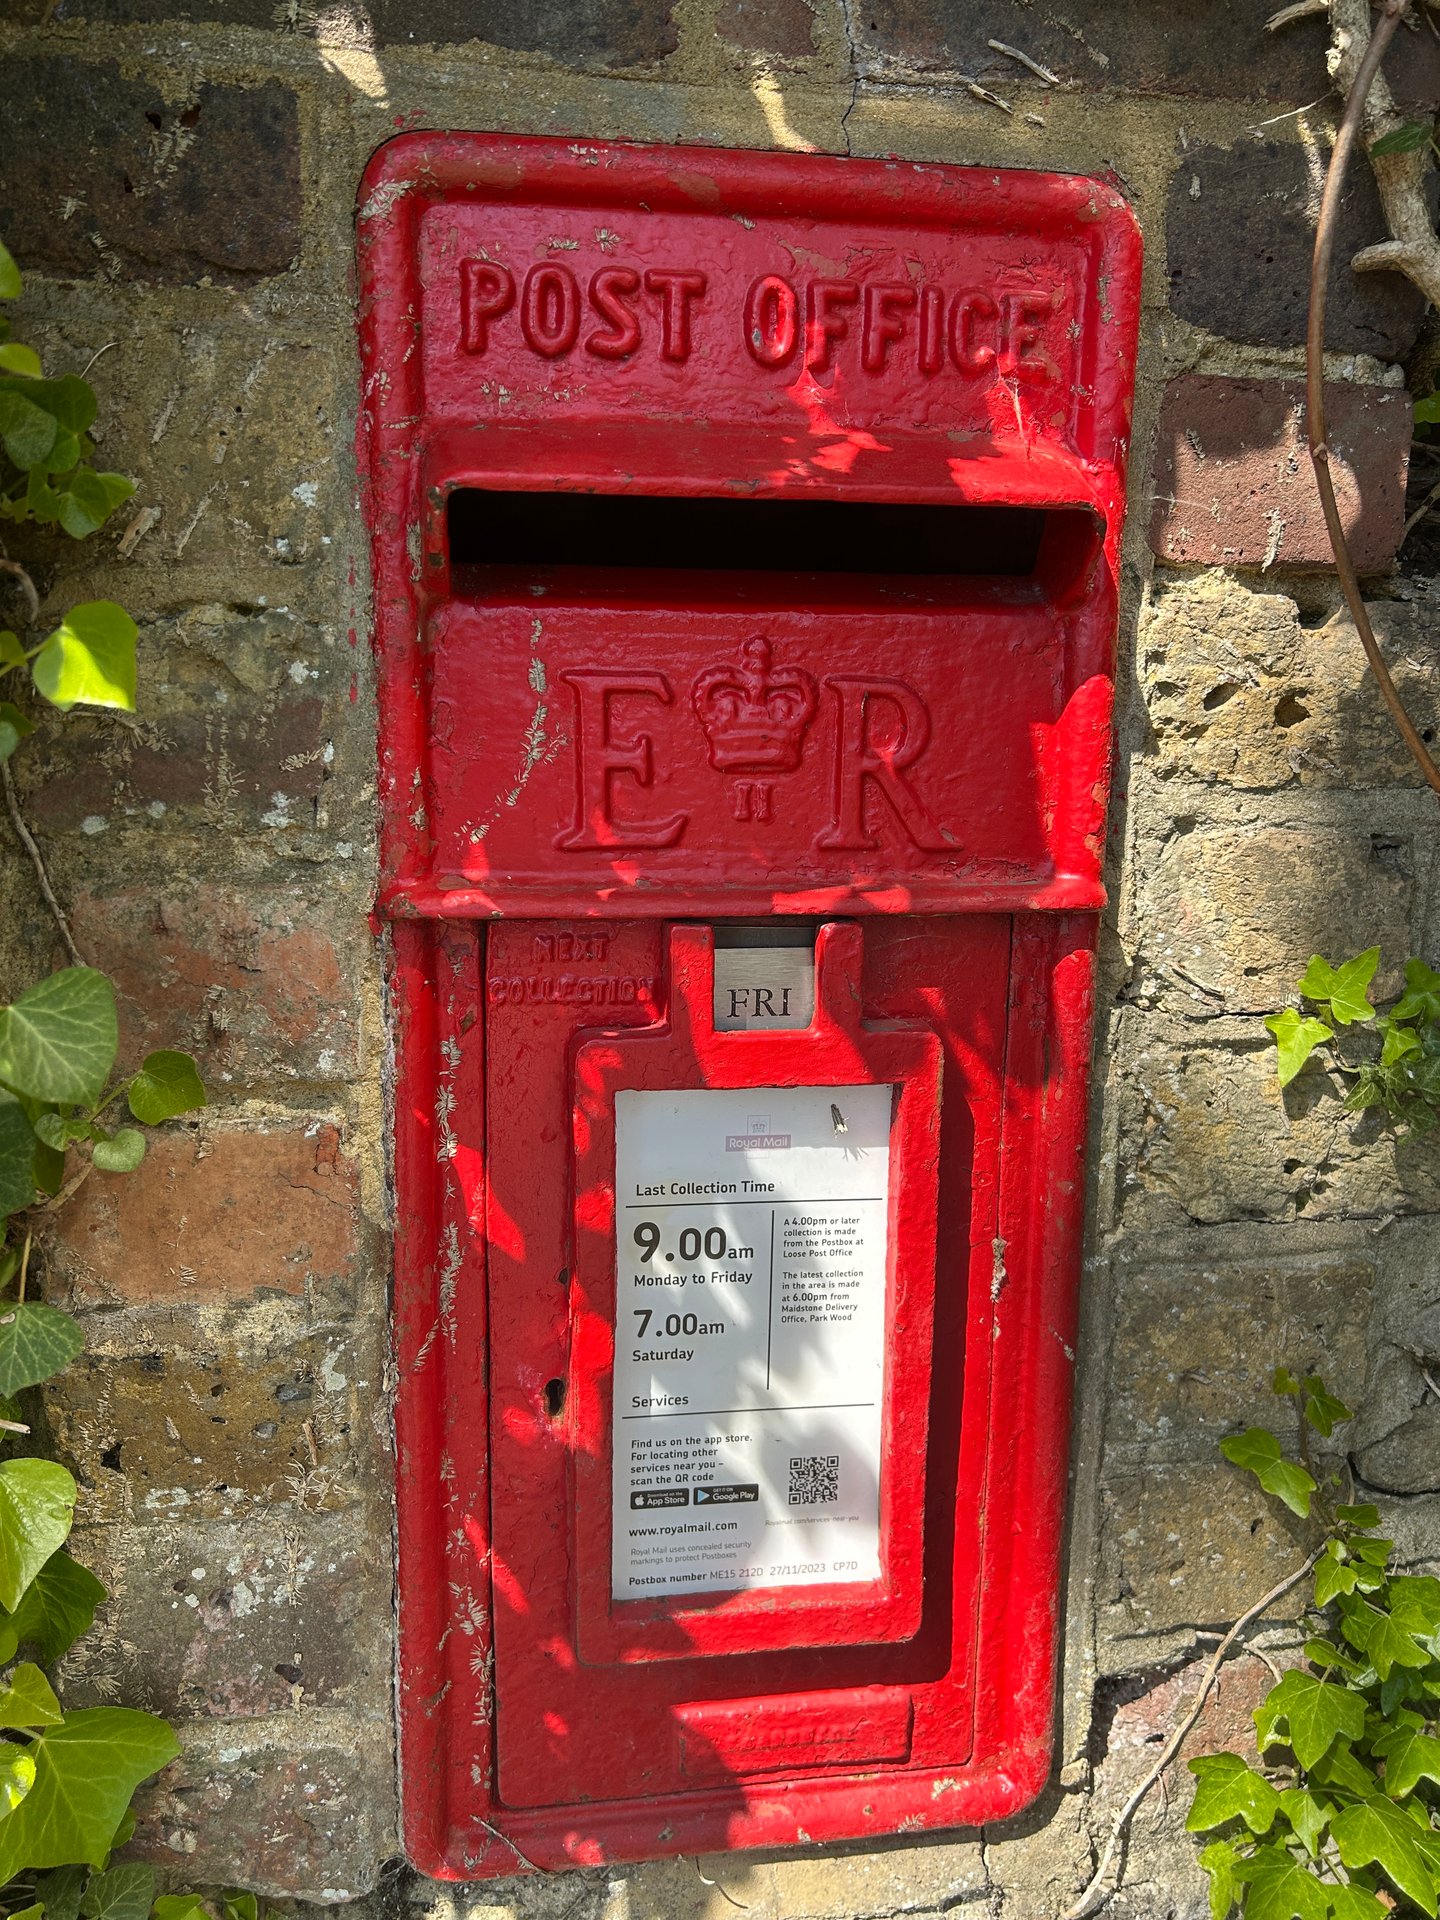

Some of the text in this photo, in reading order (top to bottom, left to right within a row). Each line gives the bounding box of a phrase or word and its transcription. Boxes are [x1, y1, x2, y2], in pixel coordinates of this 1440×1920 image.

[459, 259, 1055, 378] POST OFFICE
[551, 667, 963, 851] E R
[531, 931, 610, 962] NEXT
[489, 973, 654, 1005] COLLECTION
[727, 988, 792, 1018] FRI
[729, 1136, 788, 1150] Royal Mail
[636, 1180, 775, 1196] Last Collection Time
[784, 1218, 790, 1226] A
[792, 1216, 827, 1227] 4.00pm
[841, 1217, 860, 1225] later
[784, 1227, 856, 1237] collection is made
[633, 1221, 754, 1264] 9.00am
[784, 1239, 803, 1248] from
[806, 1239, 819, 1247] the
[821, 1238, 853, 1246] Postbox
[783, 1248, 853, 1258] Loose Post Office
[634, 1271, 753, 1288] Monday to Friday
[782, 1269, 864, 1279] The latest collection
[782, 1282, 789, 1290] in
[792, 1281, 806, 1289] the
[829, 1280, 835, 1288] is
[838, 1280, 860, 1288] made
[781, 1292, 849, 1303] at 6.00pm from
[781, 1302, 858, 1313] Maidstone Delivery
[633, 1309, 725, 1338] 7.00am
[809, 1314, 828, 1322] Park
[829, 1313, 852, 1321] Wood
[632, 1348, 694, 1362] Saturday
[632, 1394, 689, 1408] Services
[631, 1435, 753, 1449] Find us on the app store.
[631, 1447, 718, 1461] For locating other
[630, 1463, 670, 1474] services
[673, 1462, 696, 1471] near
[698, 1461, 716, 1471] you
[630, 1472, 714, 1486] scan the QR code
[647, 1496, 685, 1506] App Store
[712, 1491, 755, 1502] Google Play
[628, 1521, 738, 1537] www.royalmail.com
[630, 1547, 650, 1557] Royal
[652, 1546, 667, 1554] Mail
[687, 1543, 722, 1552] concealed
[724, 1540, 752, 1549] security
[630, 1556, 664, 1566] markings
[675, 1553, 700, 1564] protect
[701, 1551, 737, 1560] Postboxes
[629, 1561, 858, 1586] Postbox number ME15 212D 27/11/2023 CP7D
